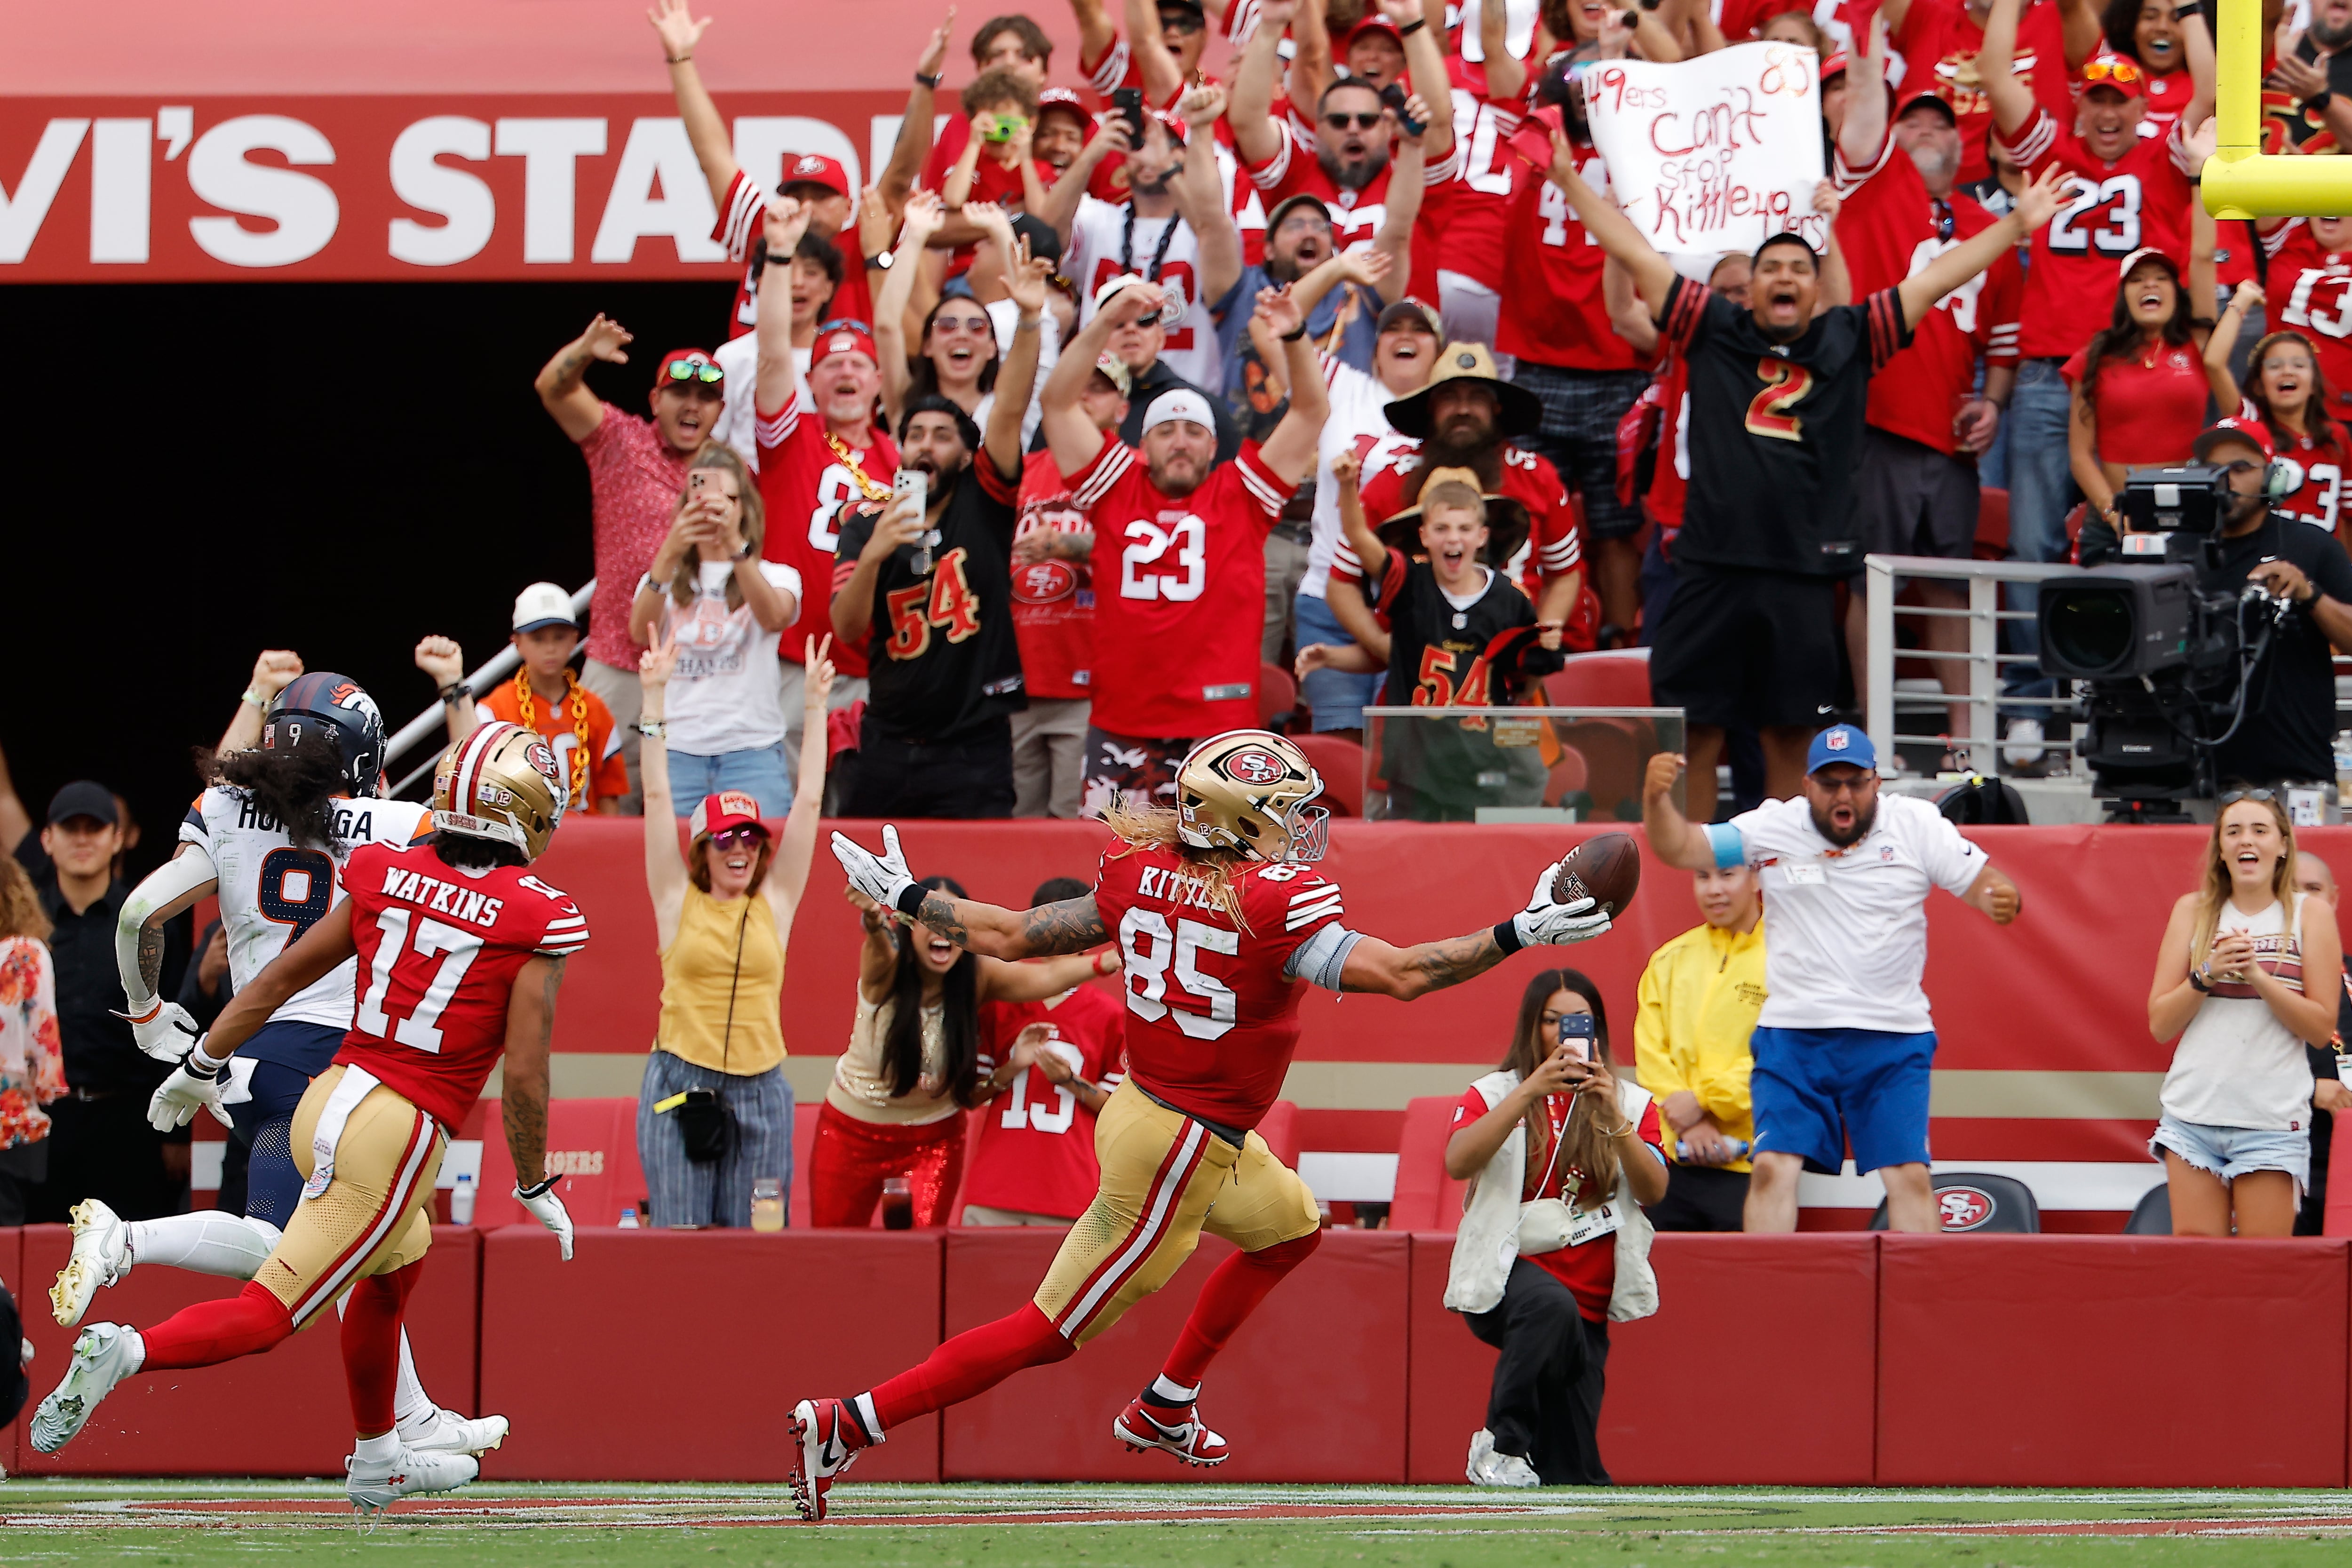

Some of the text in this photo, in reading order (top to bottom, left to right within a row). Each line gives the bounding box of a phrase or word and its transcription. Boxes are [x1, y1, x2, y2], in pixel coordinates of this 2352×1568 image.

[2049, 174, 2143, 257] 23
[2280, 268, 2352, 338] 13
[1744, 358, 1813, 442] 2
[1120, 514, 1206, 602] 23
[886, 546, 980, 661] 54
[1412, 644, 1493, 732] 54
[288, 723, 302, 747] 9
[499, 793, 510, 804] 12
[1200, 825, 1209, 836] 12
[258, 847, 335, 950] 9
[381, 867, 504, 927] WATKINS
[356, 907, 485, 1054] 17
[1119, 906, 1239, 1041] 85
[1001, 1040, 1085, 1134] 13
